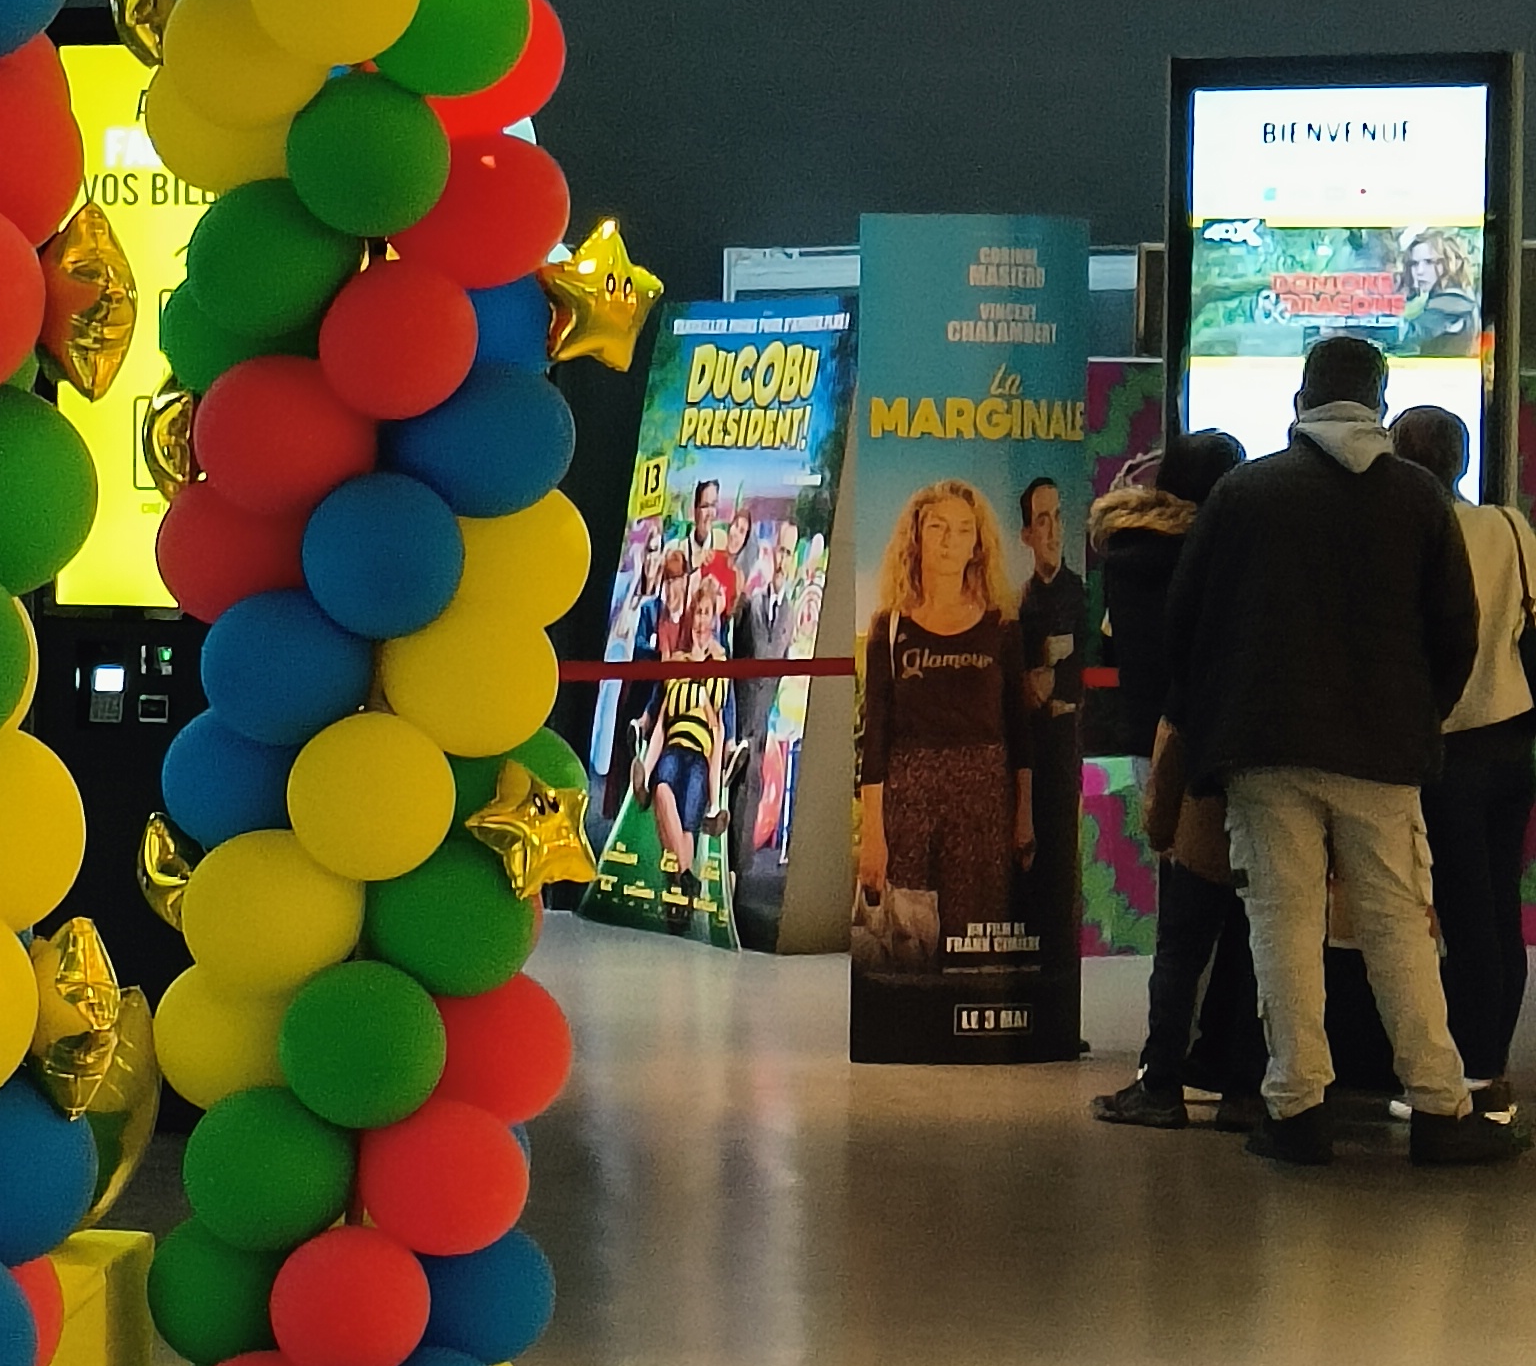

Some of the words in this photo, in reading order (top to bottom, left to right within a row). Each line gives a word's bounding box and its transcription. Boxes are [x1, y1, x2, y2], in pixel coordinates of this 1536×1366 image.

[83, 173, 139, 205] VOS
[685, 340, 821, 409] DUCOBU
[990, 363, 1022, 396] La
[870, 396, 1085, 441] MARGINALE
[643, 463, 662, 496] 13
[902, 648, 994, 679] Glamour
[999, 1010, 1028, 1029] MAI
